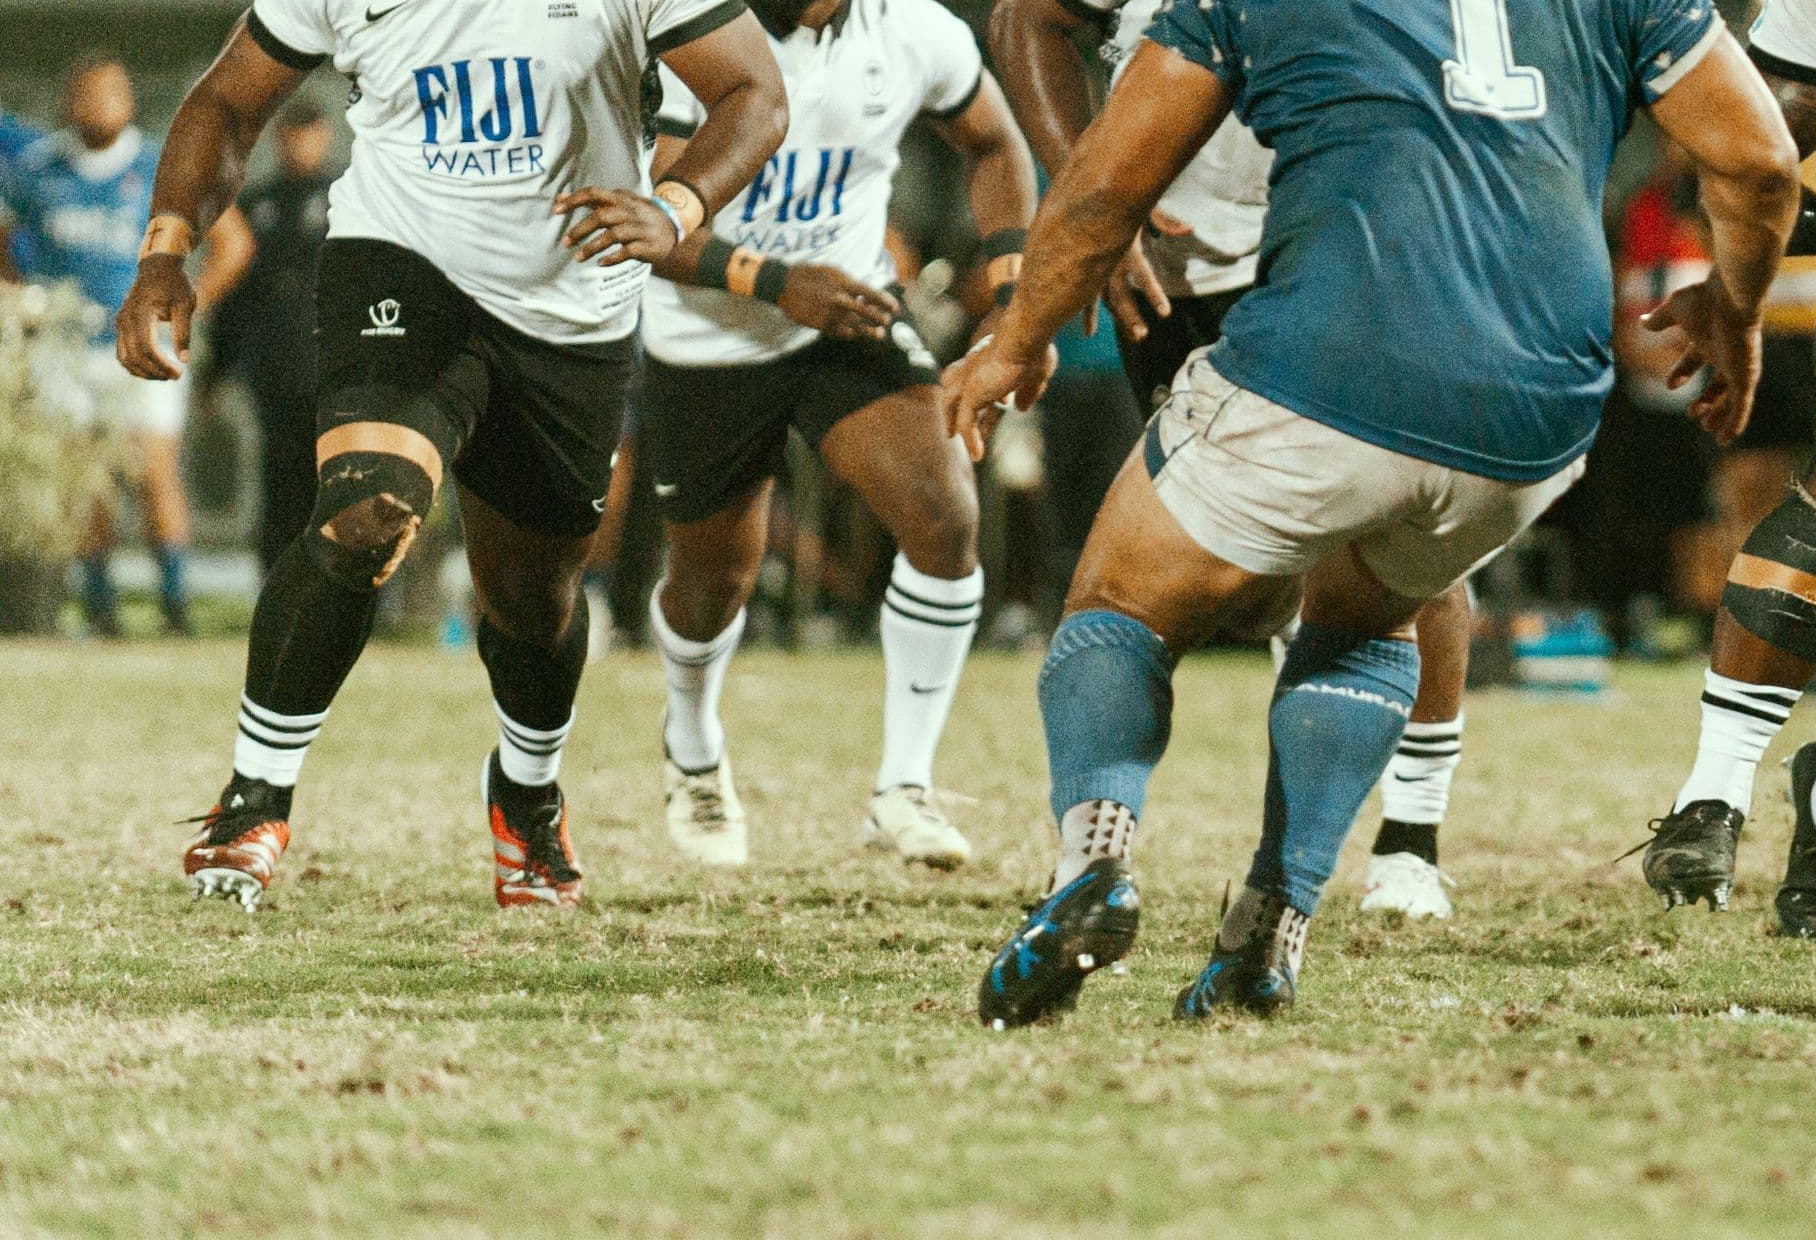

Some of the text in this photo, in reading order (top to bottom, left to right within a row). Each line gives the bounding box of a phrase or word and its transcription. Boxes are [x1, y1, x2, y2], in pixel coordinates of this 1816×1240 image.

[412, 57, 543, 144] FIJI
[422, 144, 546, 176] WATER
[740, 146, 855, 223] FIJI
[1284, 682, 1412, 718] AMURAI
